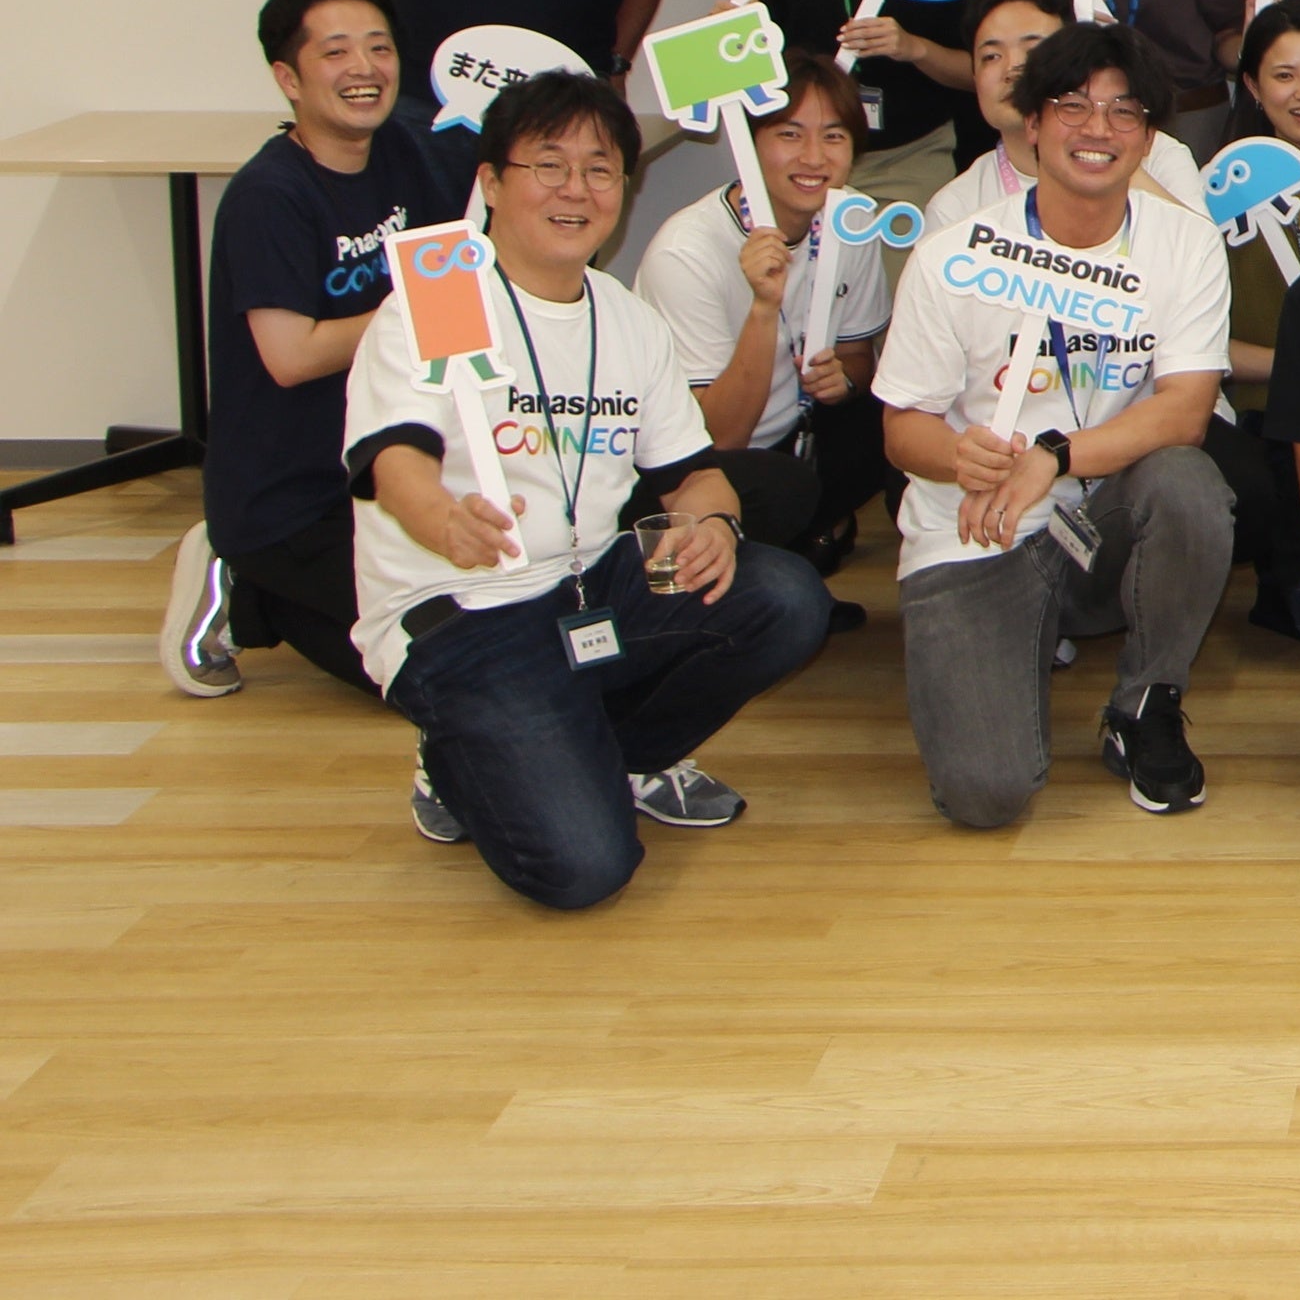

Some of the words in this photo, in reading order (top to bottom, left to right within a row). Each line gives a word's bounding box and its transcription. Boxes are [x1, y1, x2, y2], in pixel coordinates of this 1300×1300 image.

[967, 222, 1141, 294] Panasonic
[943, 253, 1143, 333] CONNECT
[508, 386, 638, 416] Panasonic
[492, 420, 640, 456] CONNECT
